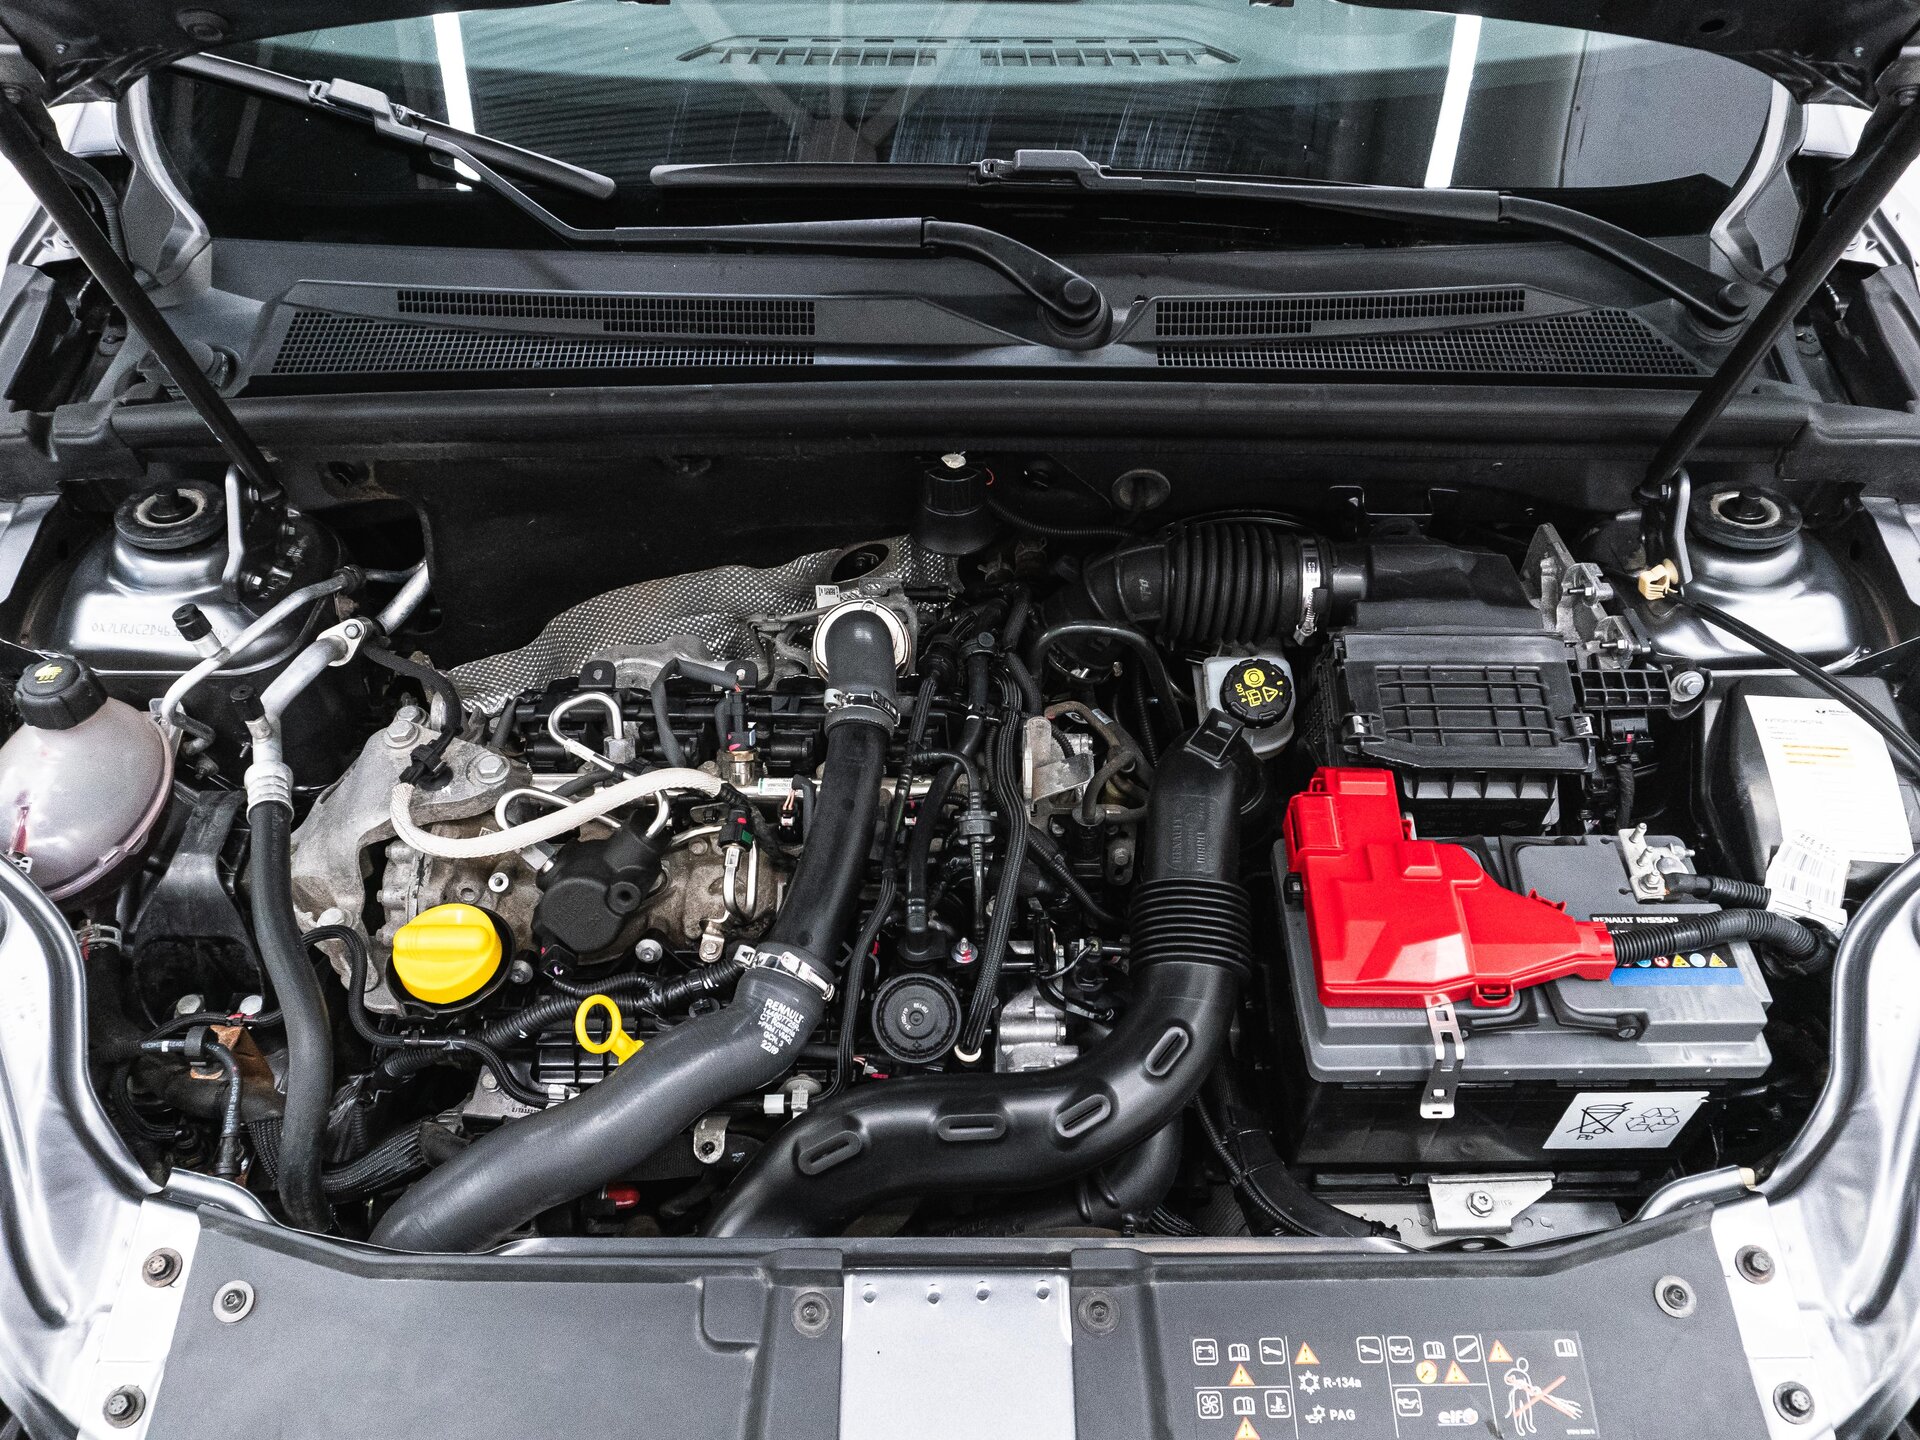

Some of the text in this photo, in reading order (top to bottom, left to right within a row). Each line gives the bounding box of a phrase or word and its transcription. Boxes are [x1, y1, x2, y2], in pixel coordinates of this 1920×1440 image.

[1234, 682, 1246, 696] DOT
[764, 998, 804, 1023] RENAULT
[759, 1013, 772, 1024] CT
[1323, 1376, 1362, 1388] R-134a
[1329, 1409, 1356, 1421] PAG
